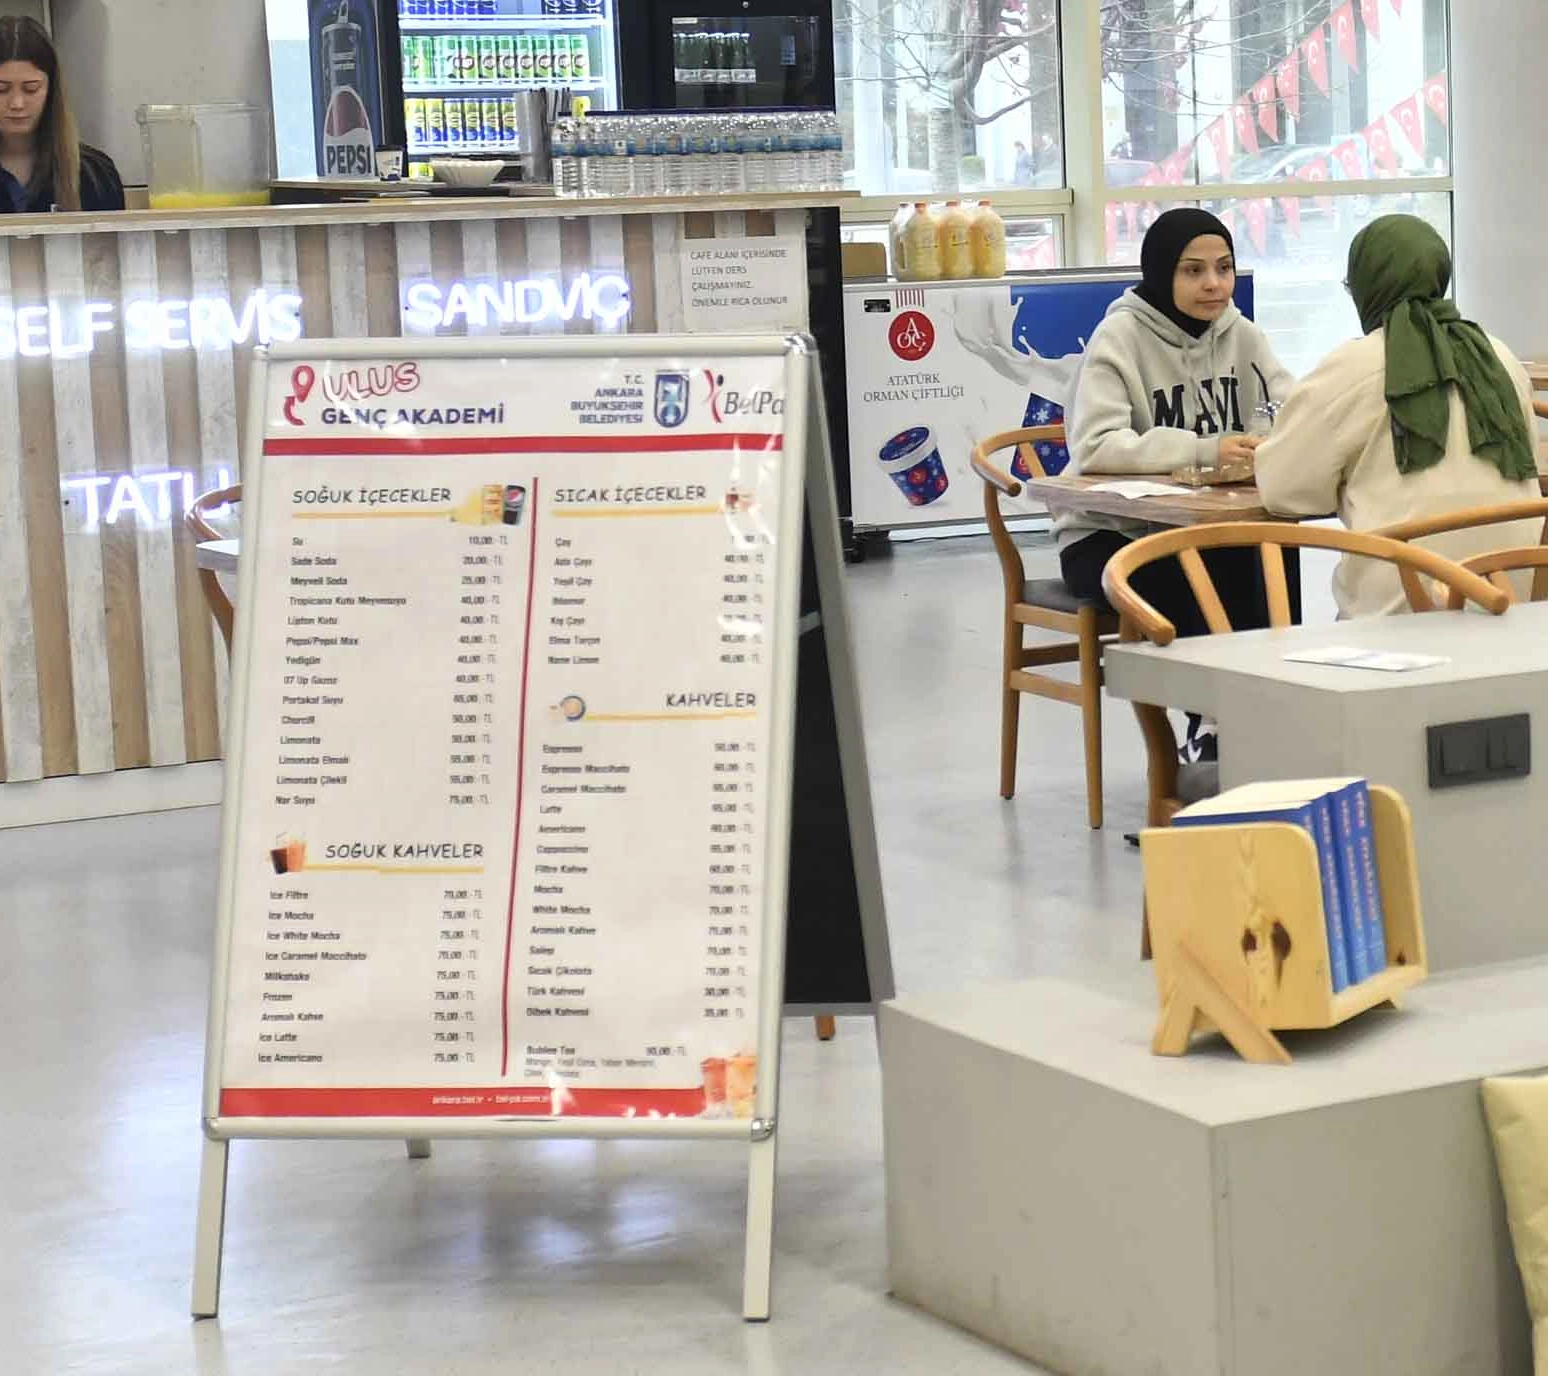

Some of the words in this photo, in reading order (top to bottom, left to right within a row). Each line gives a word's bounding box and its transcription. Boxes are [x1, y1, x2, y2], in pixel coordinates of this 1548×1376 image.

[326, 144, 372, 174] PEPSI
[726, 265, 747, 274] DERS
[403, 273, 630, 332] SANDVİÇ
[124, 288, 302, 351] SERVİS
[323, 362, 420, 401] ULUS
[624, 374, 645, 385] T.C.
[886, 372, 941, 387] ATATÜRK
[595, 388, 644, 398] ANKARA
[863, 390, 910, 403] ORMAN
[911, 385, 965, 401] ÇİFTLİĞİ
[1153, 365, 1245, 436] MAVİ
[321, 407, 387, 430] GENÇ
[393, 403, 504, 425] AKADEMİ
[293, 485, 353, 504] SOĞUK
[359, 487, 452, 505] İÇECEKLER
[554, 488, 610, 502] SICAK
[615, 485, 706, 504] İÇECEKLER
[666, 692, 756, 708] KAHVELER
[325, 841, 387, 860] SOĞUK
[392, 843, 484, 858] KAHVELER
